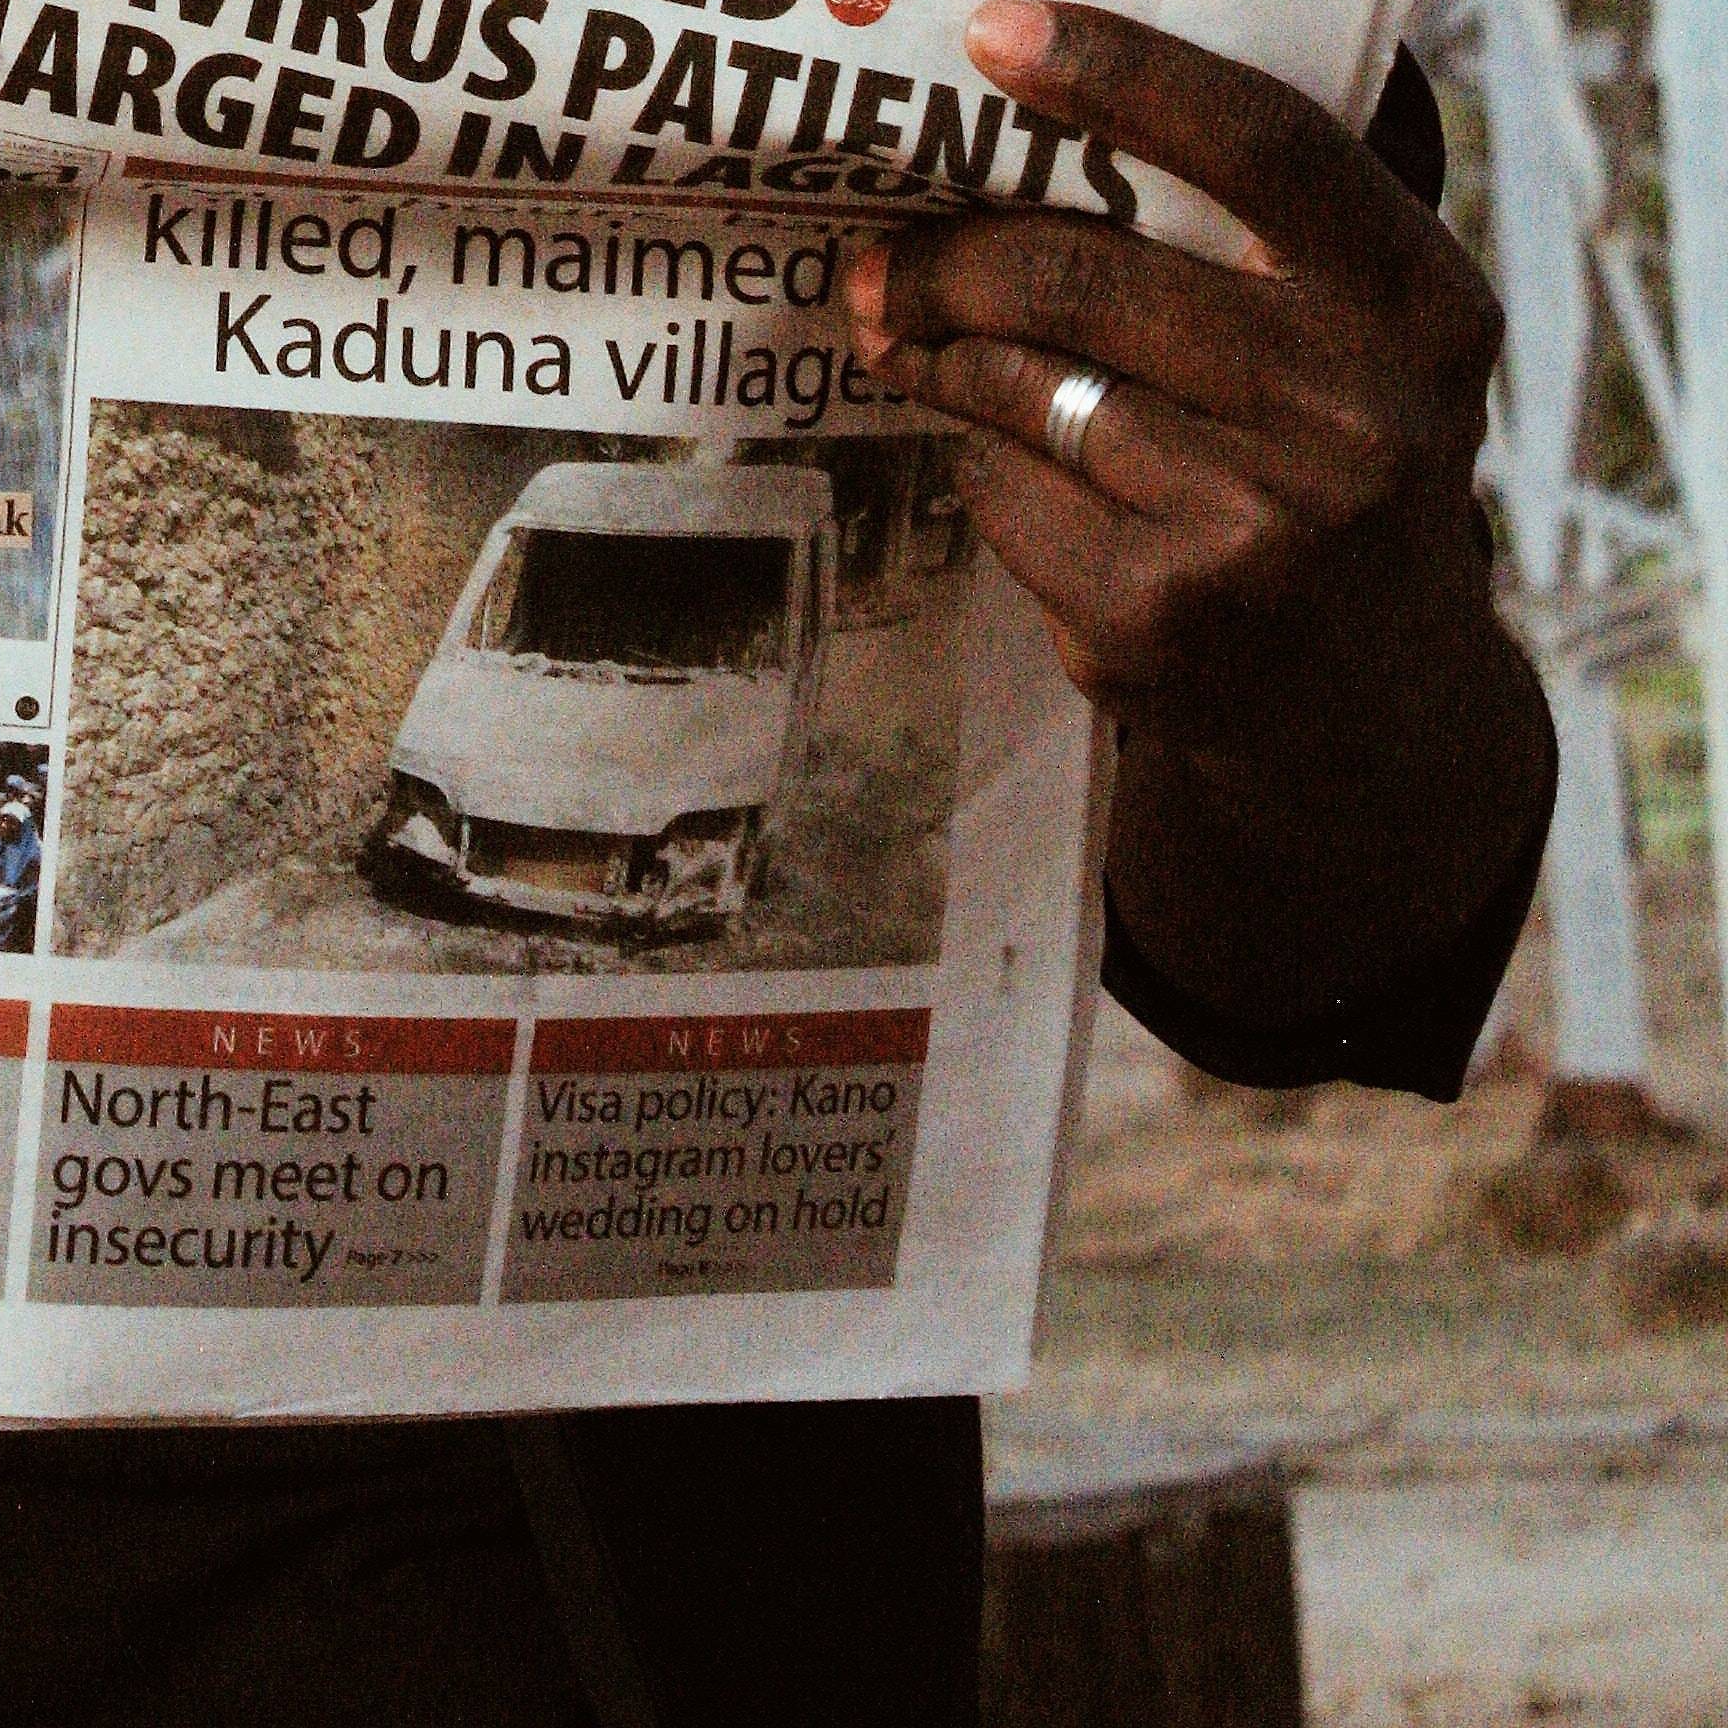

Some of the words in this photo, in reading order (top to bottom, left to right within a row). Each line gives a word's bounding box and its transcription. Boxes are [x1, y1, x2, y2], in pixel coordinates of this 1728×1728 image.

[562, 9, 1138, 225] PATIENTS
[446, 110, 589, 182] IN
[610, 142, 972, 208] LAGO
[451, 219, 839, 308] maimed
[214, 291, 571, 398] Kaduna
[605, 319, 908, 430] village
[213, 1026, 363, 1059] NEWS
[669, 1029, 801, 1056] NEWS
[60, 1070, 377, 1136] North-East
[537, 1079, 623, 1124] Visa
[634, 1073, 776, 1131] policy:
[789, 1075, 897, 1117] Kano
[52, 1154, 195, 1212] govs
[212, 1156, 369, 1203] meet
[378, 1162, 450, 1201] on
[46, 1207, 336, 1282] insecurity
[522, 1195, 713, 1246] wedding
[725, 1199, 779, 1234] on
[792, 1187, 890, 1230] hold
